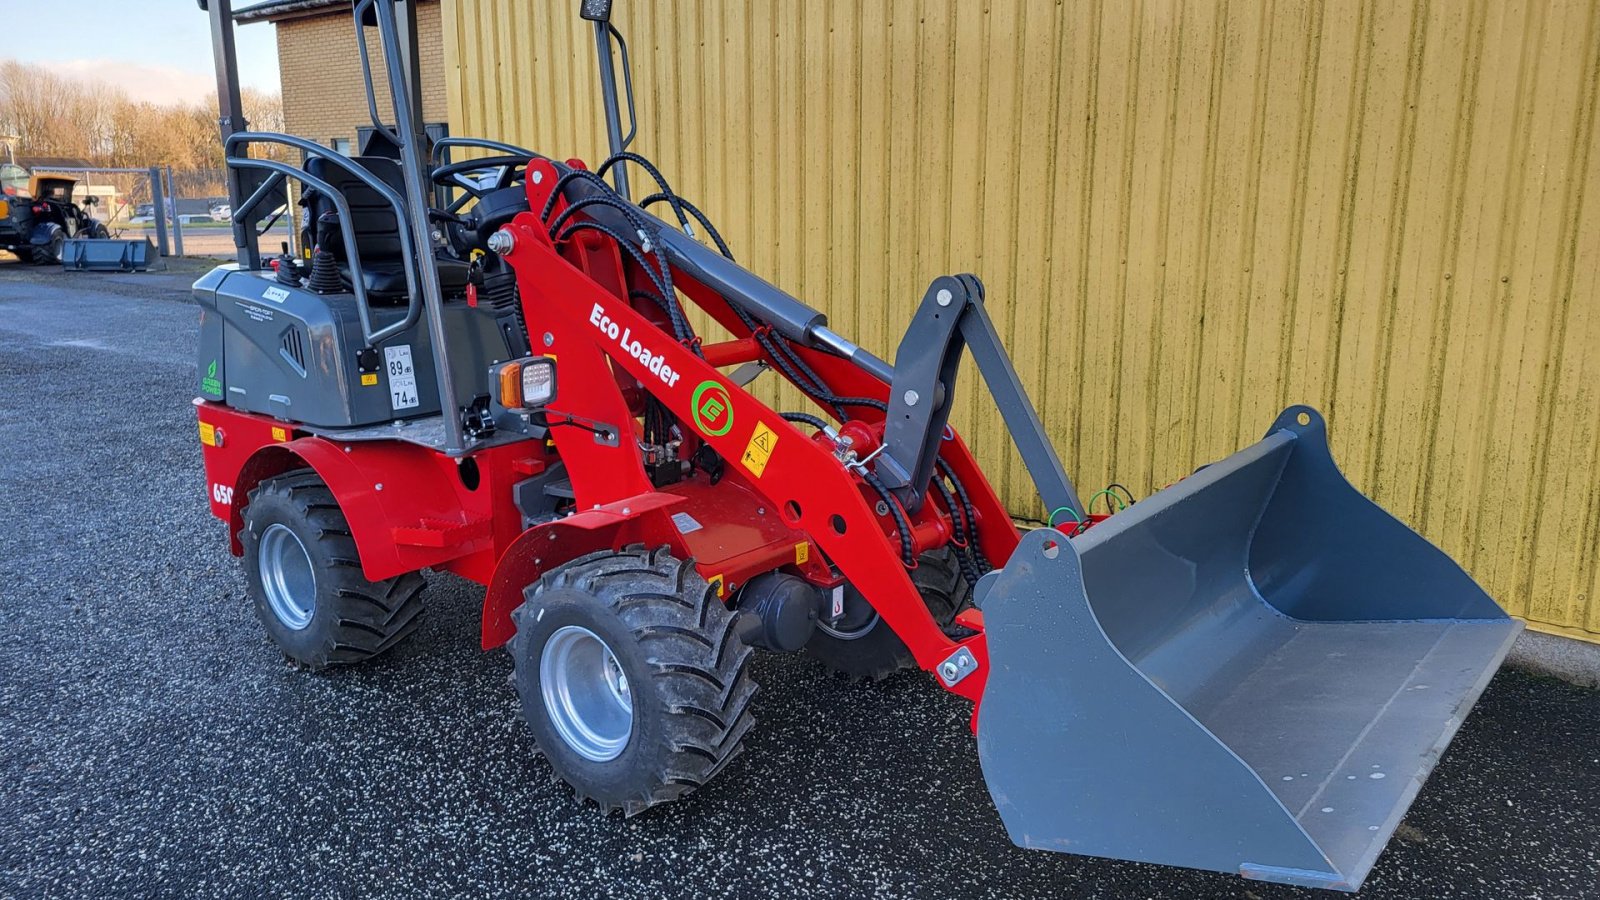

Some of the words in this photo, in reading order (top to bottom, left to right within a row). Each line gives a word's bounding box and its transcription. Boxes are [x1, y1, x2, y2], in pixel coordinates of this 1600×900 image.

[589, 302, 619, 340] Eco
[620, 327, 680, 389] Loader
[390, 360, 403, 376] 89
[202, 376, 221, 388] GREEN
[201, 384, 222, 397] POWER
[394, 391, 408, 407] 74
[213, 482, 234, 506] 650
